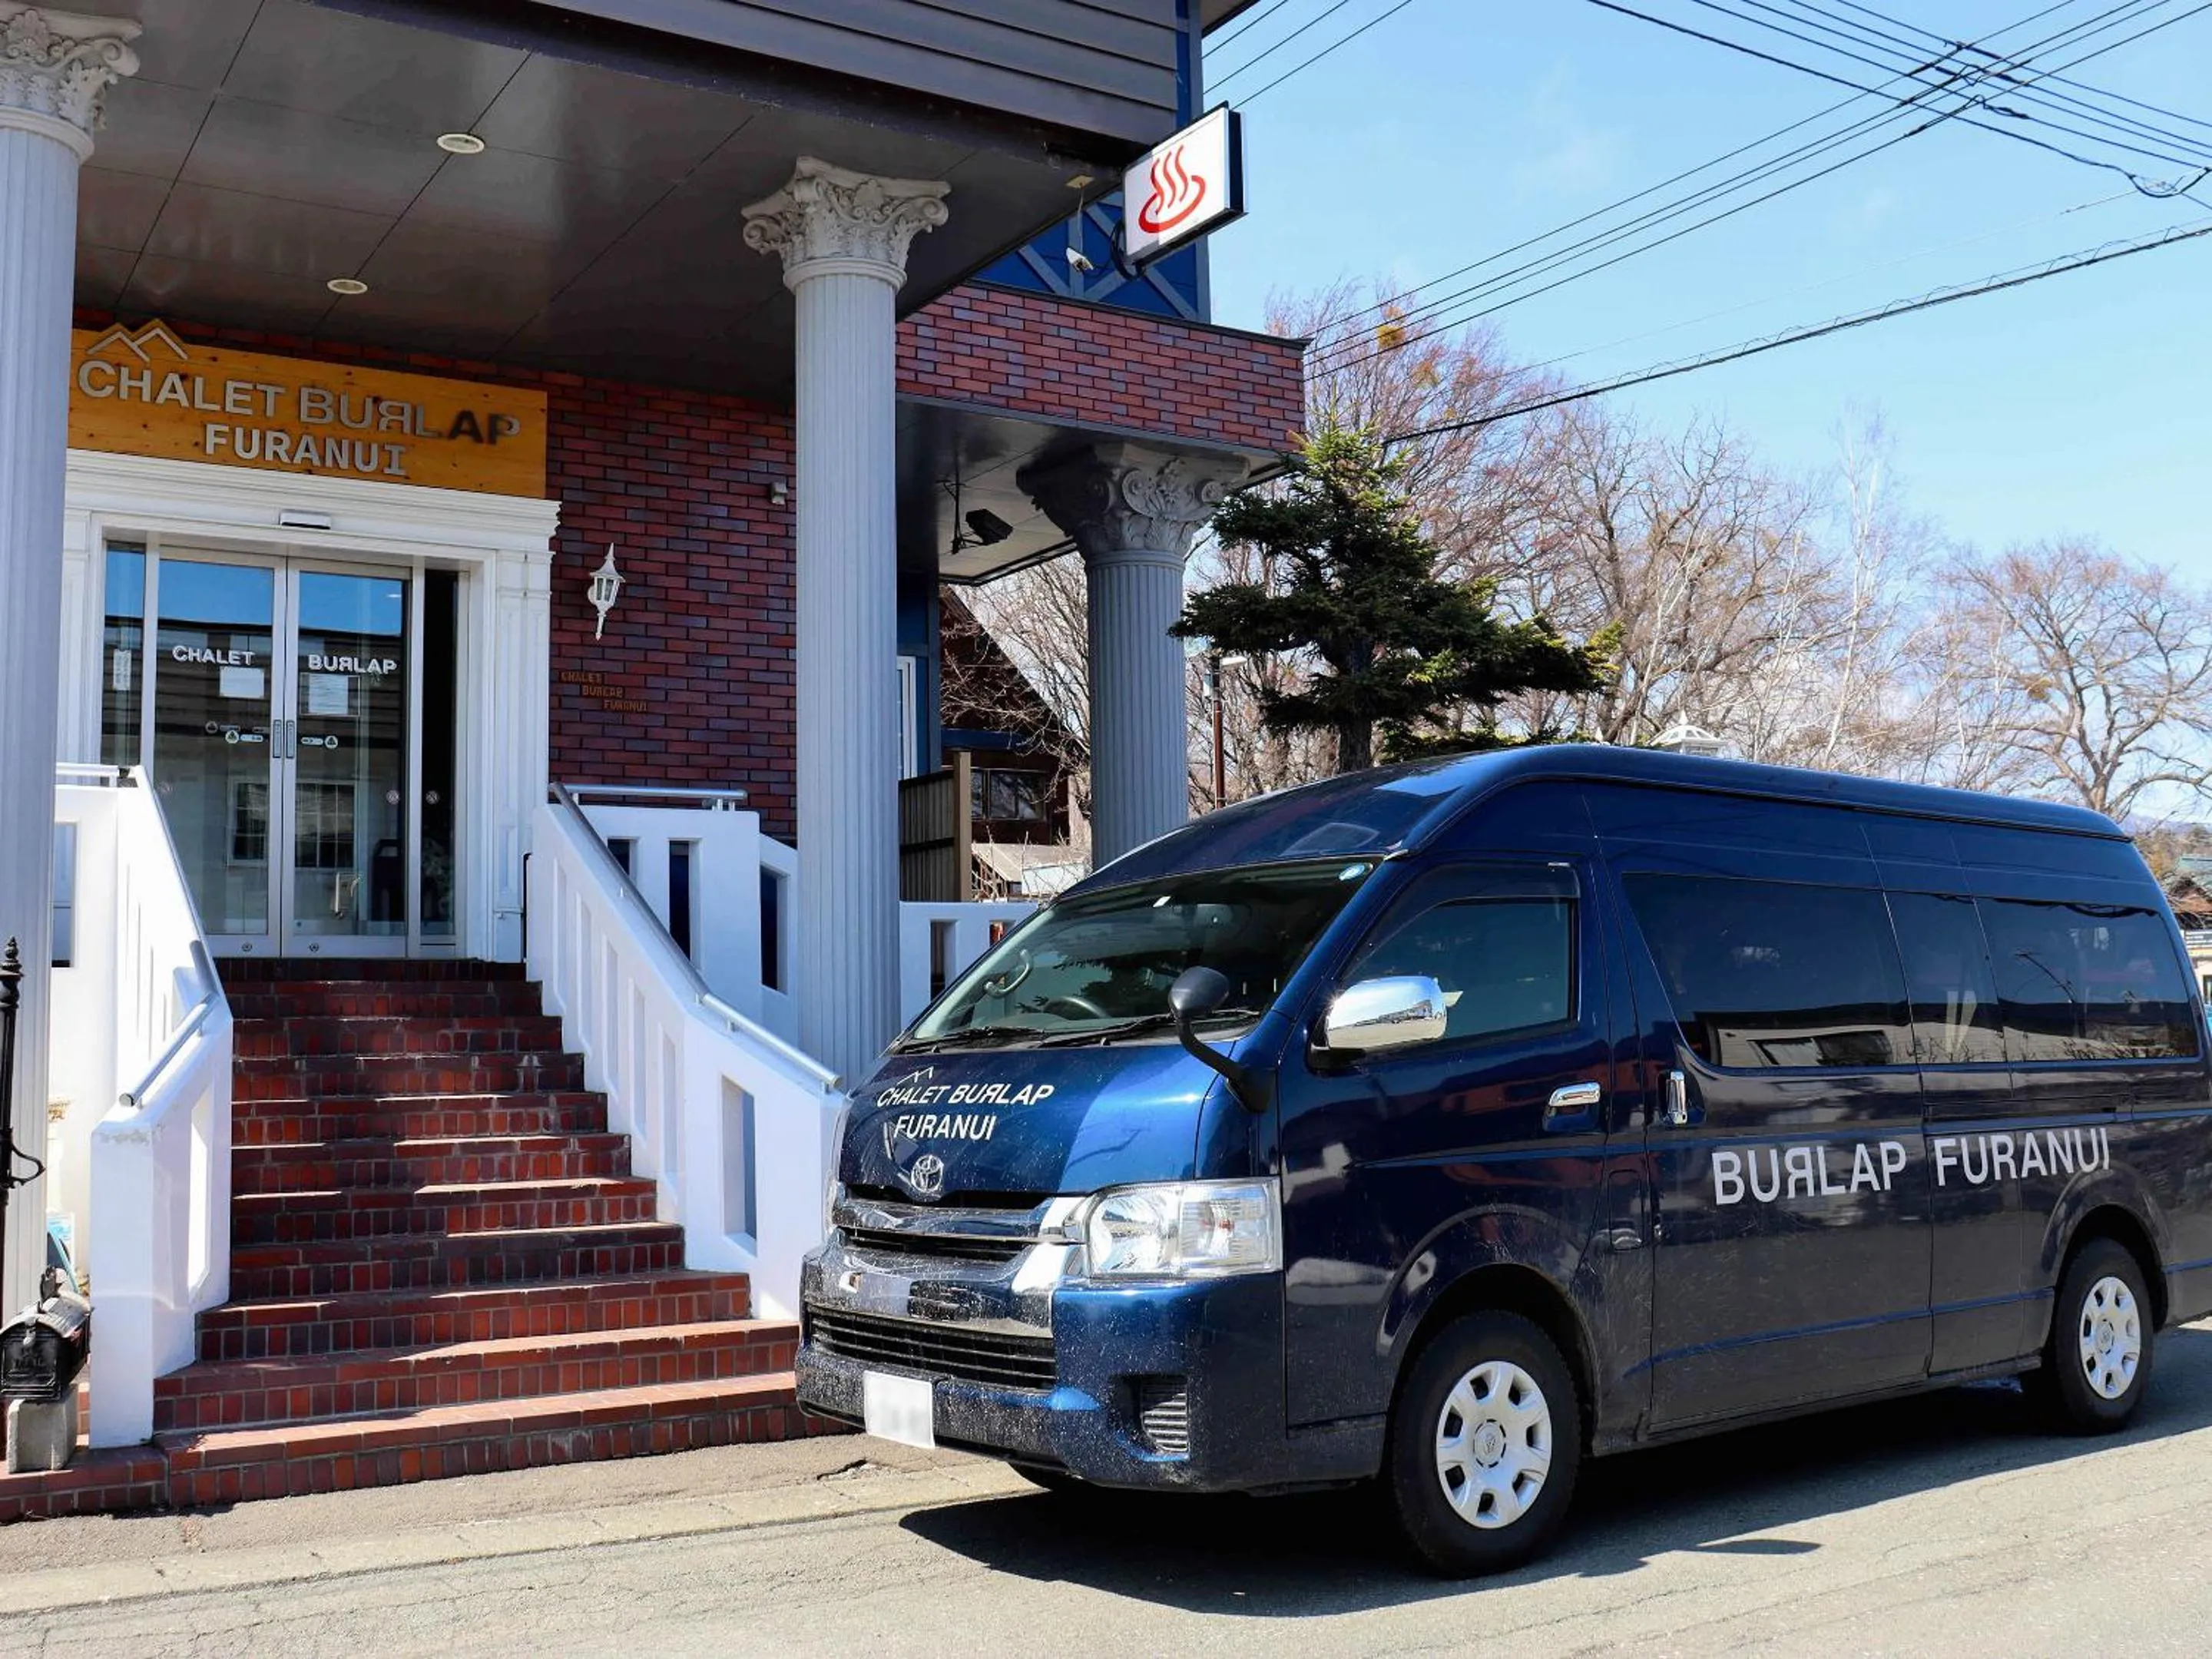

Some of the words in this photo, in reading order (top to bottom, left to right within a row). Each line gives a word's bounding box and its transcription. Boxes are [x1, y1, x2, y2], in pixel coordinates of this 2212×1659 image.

[78, 359, 285, 417] CHALET
[205, 423, 407, 476] FURANUI
[171, 645, 256, 666] CHALET
[561, 671, 602, 684] CHALET
[876, 1084, 952, 1108] CHALET
[893, 1114, 997, 1141] FURANUI
[1934, 1127, 2110, 1187] FURANUI
